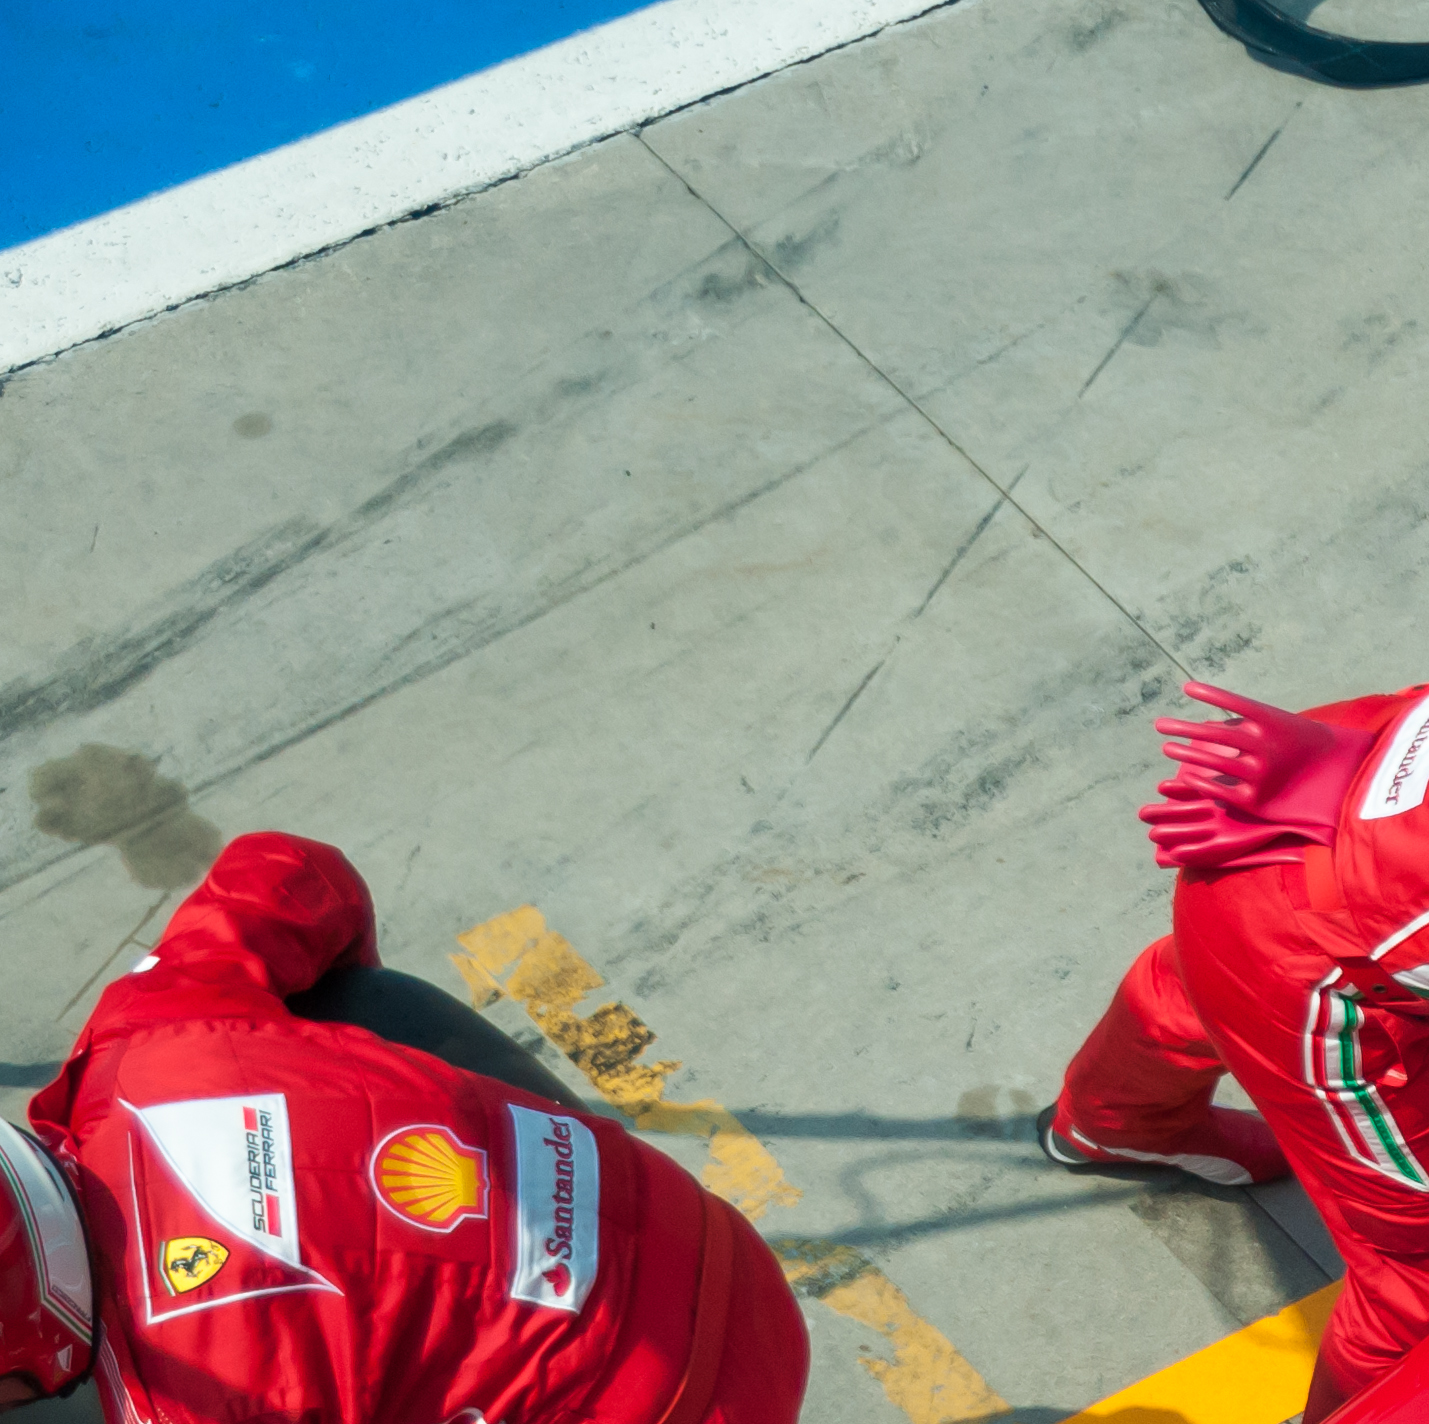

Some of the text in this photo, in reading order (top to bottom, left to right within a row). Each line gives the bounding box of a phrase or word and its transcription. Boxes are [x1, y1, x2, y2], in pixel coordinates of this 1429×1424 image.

[248, 1131, 267, 1232] SCUDERIA
[260, 1109, 280, 1192] FERRARI
[544, 1118, 575, 1261] Santander
